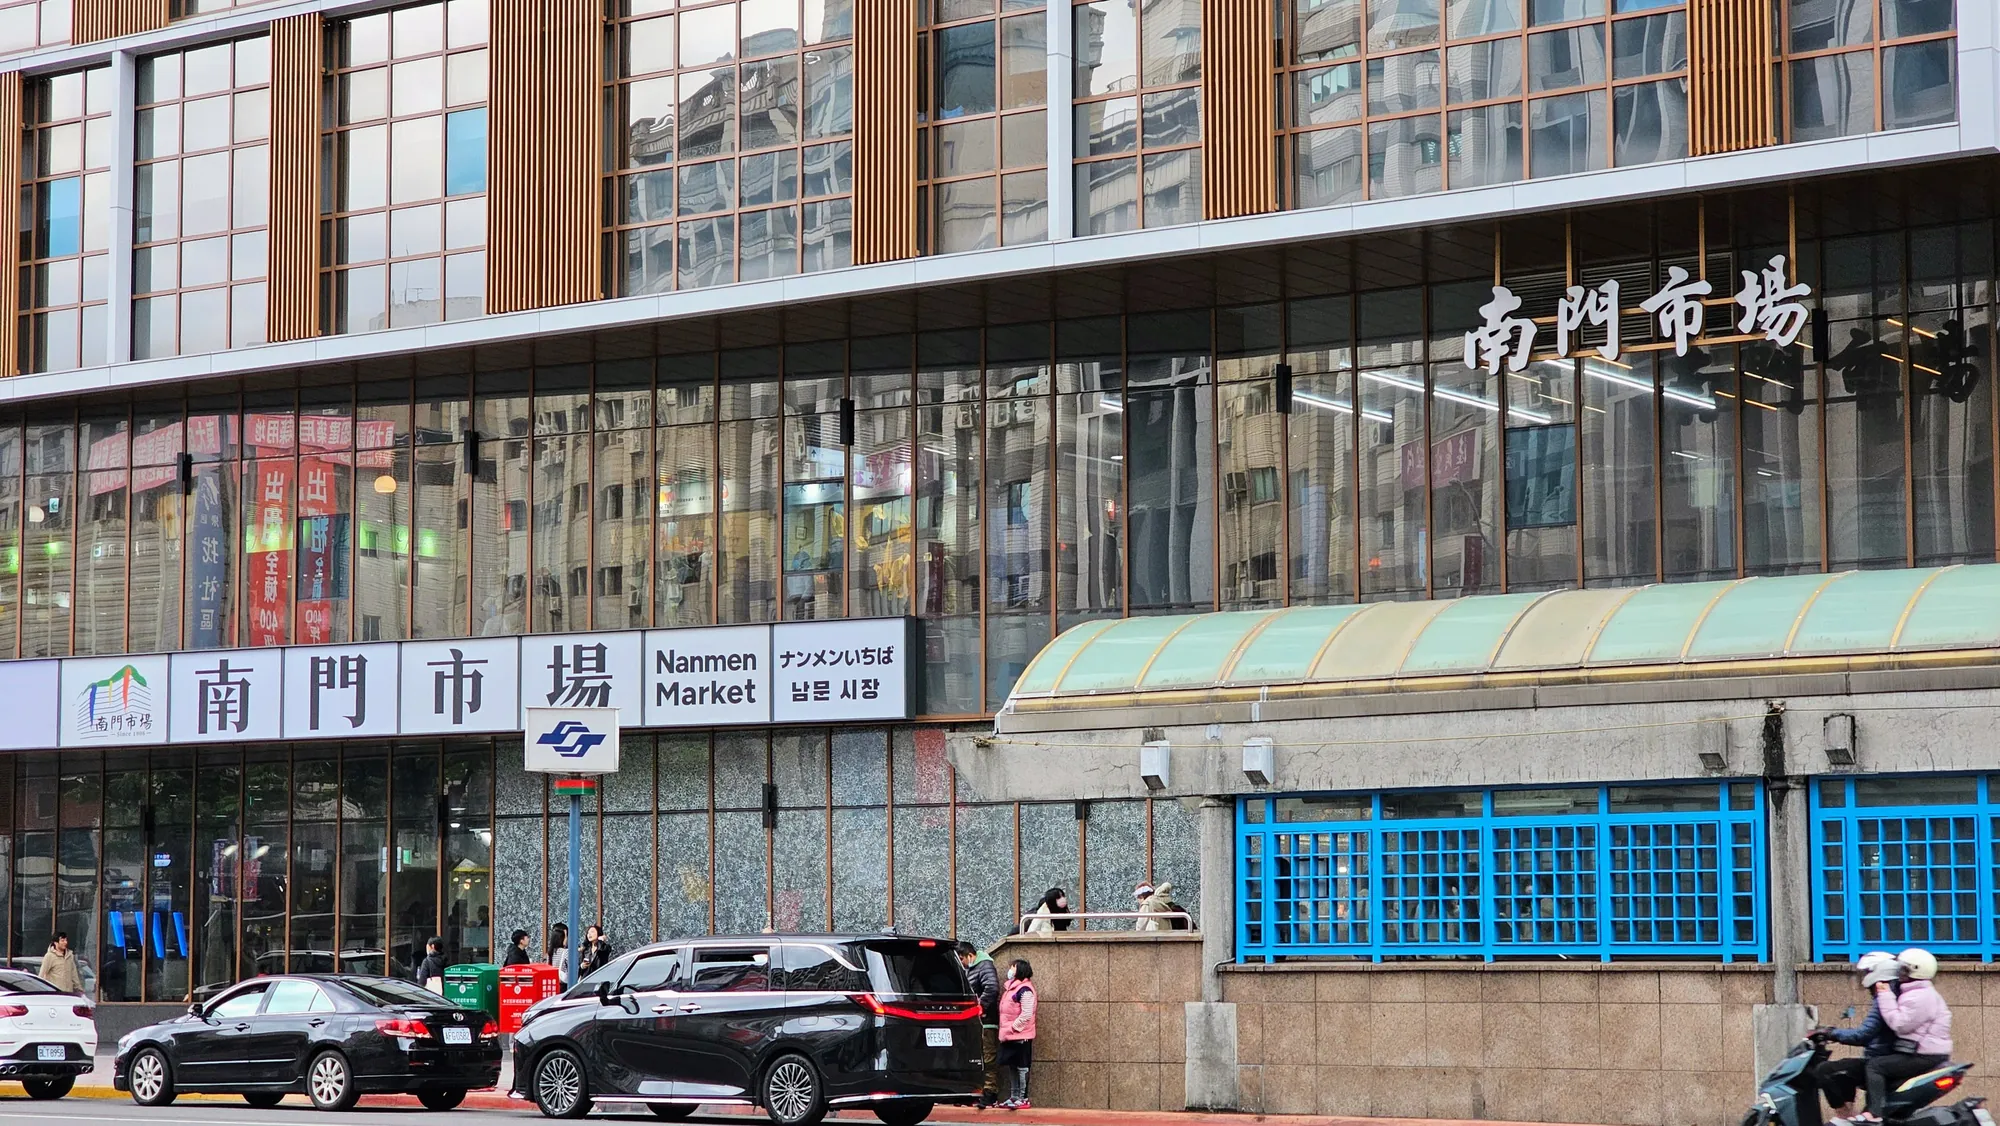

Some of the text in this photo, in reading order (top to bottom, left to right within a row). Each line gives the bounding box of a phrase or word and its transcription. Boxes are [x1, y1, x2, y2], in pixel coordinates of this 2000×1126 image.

[1464, 254, 1811, 375] 南門市場
[656, 650, 757, 674] Nanmen
[780, 645, 894, 669] ナンメンいちば
[195, 642, 613, 735] 南門市場
[656, 679, 756, 706] Market
[792, 678, 880, 702] 남문 시장
[96, 714, 152, 731] 南門市場
